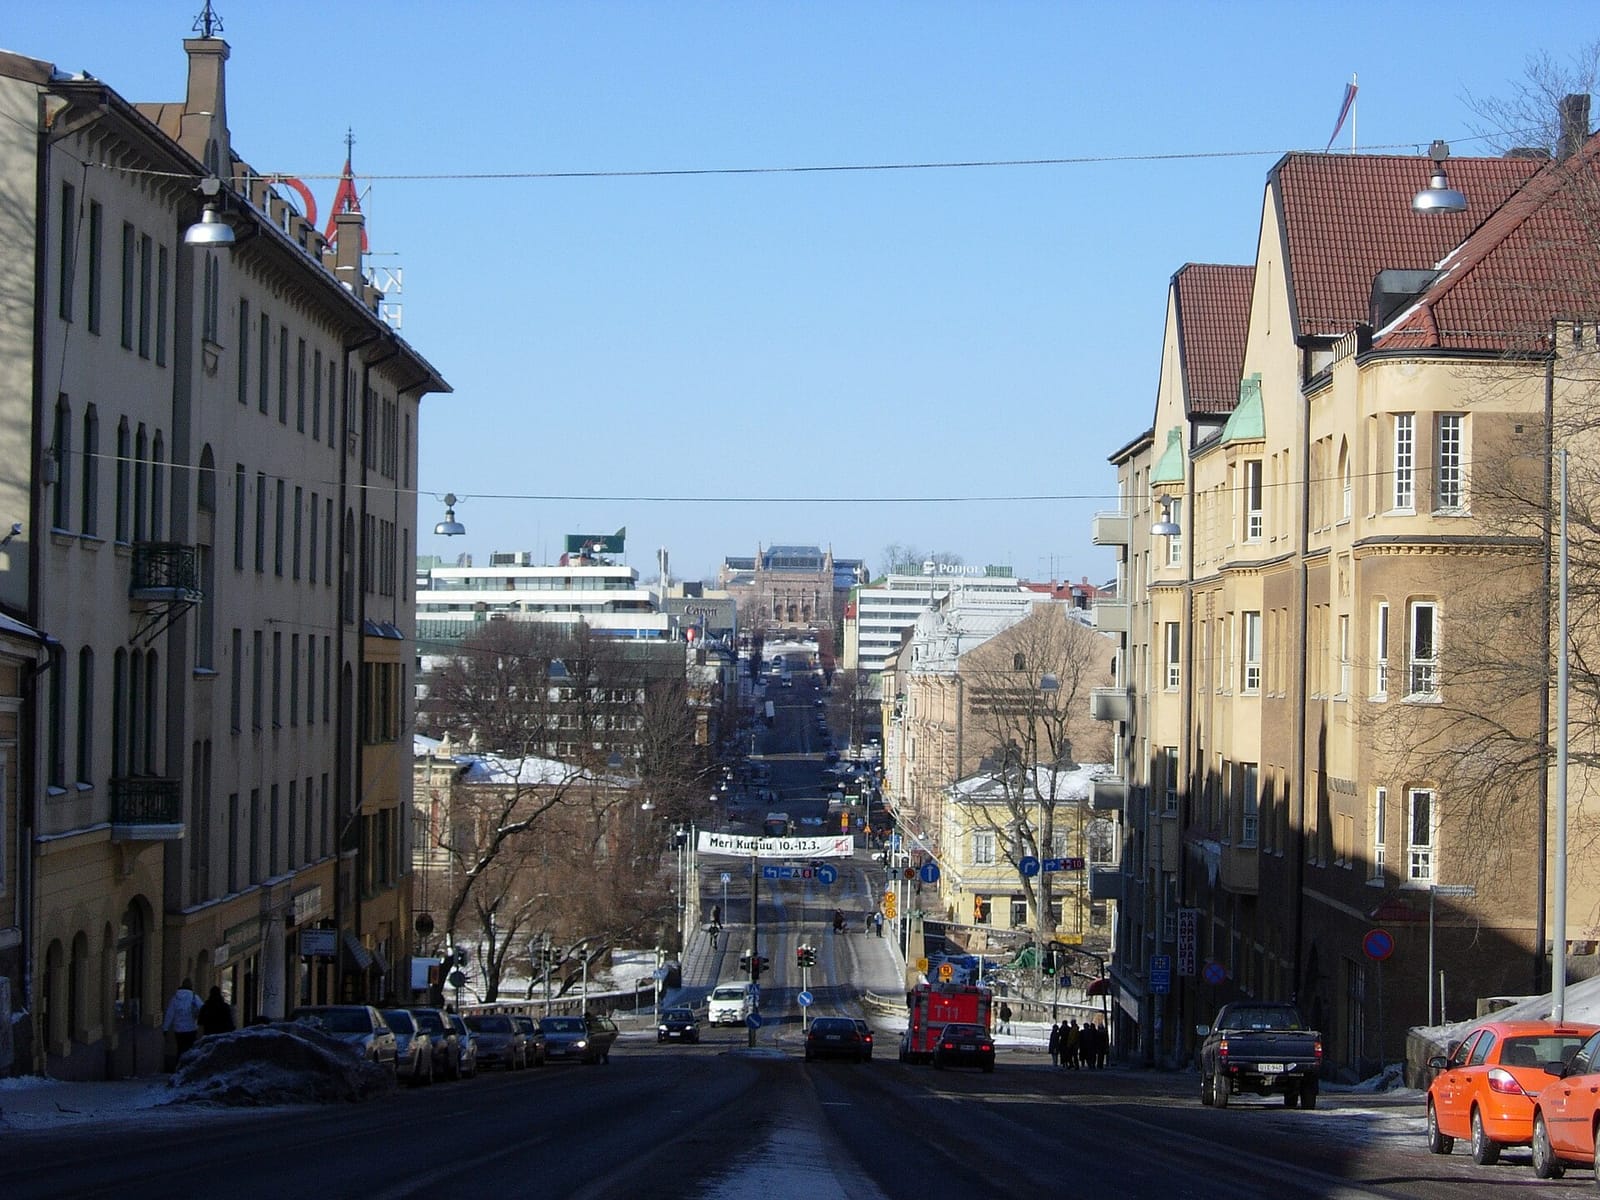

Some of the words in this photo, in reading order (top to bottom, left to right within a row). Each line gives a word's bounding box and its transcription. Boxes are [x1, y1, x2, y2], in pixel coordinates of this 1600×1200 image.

[685, 605, 717, 617] Canon
[710, 838, 733, 849] Meri
[934, 1005, 959, 1020] T11
